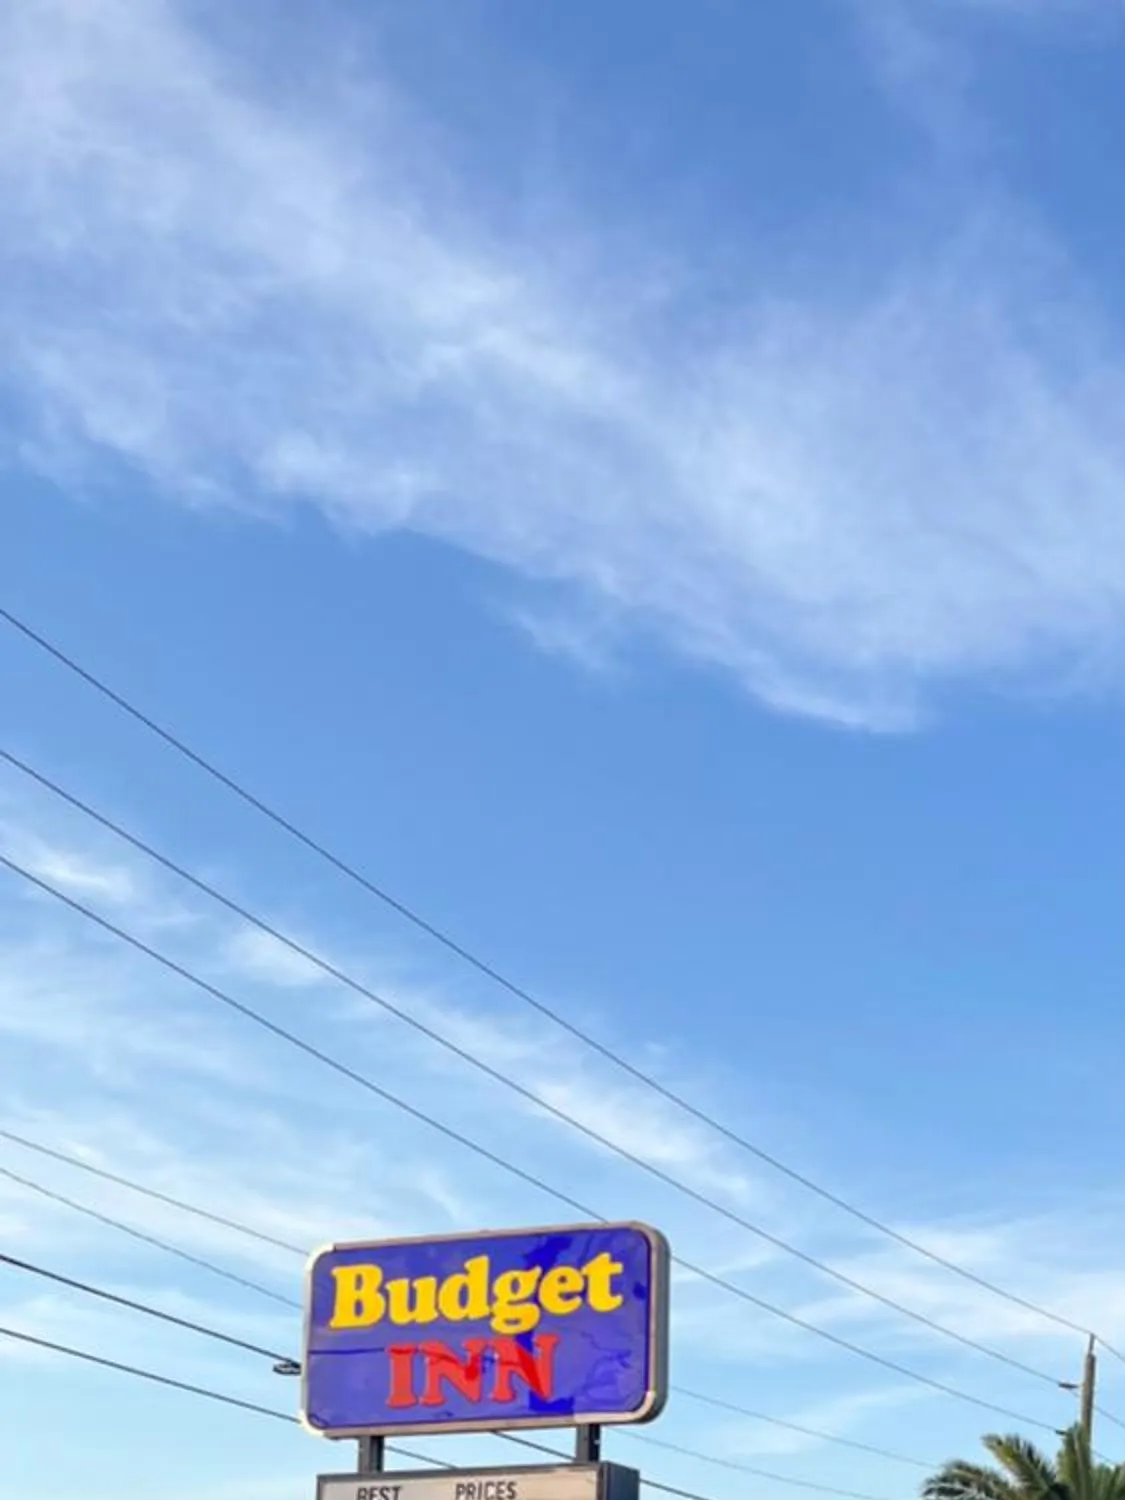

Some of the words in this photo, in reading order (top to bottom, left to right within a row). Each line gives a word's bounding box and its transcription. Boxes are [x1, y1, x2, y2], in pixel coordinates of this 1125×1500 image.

[329, 1252, 624, 1335] Budget
[387, 1333, 559, 1408] INN
[455, 1481, 517, 1500] PRICES
